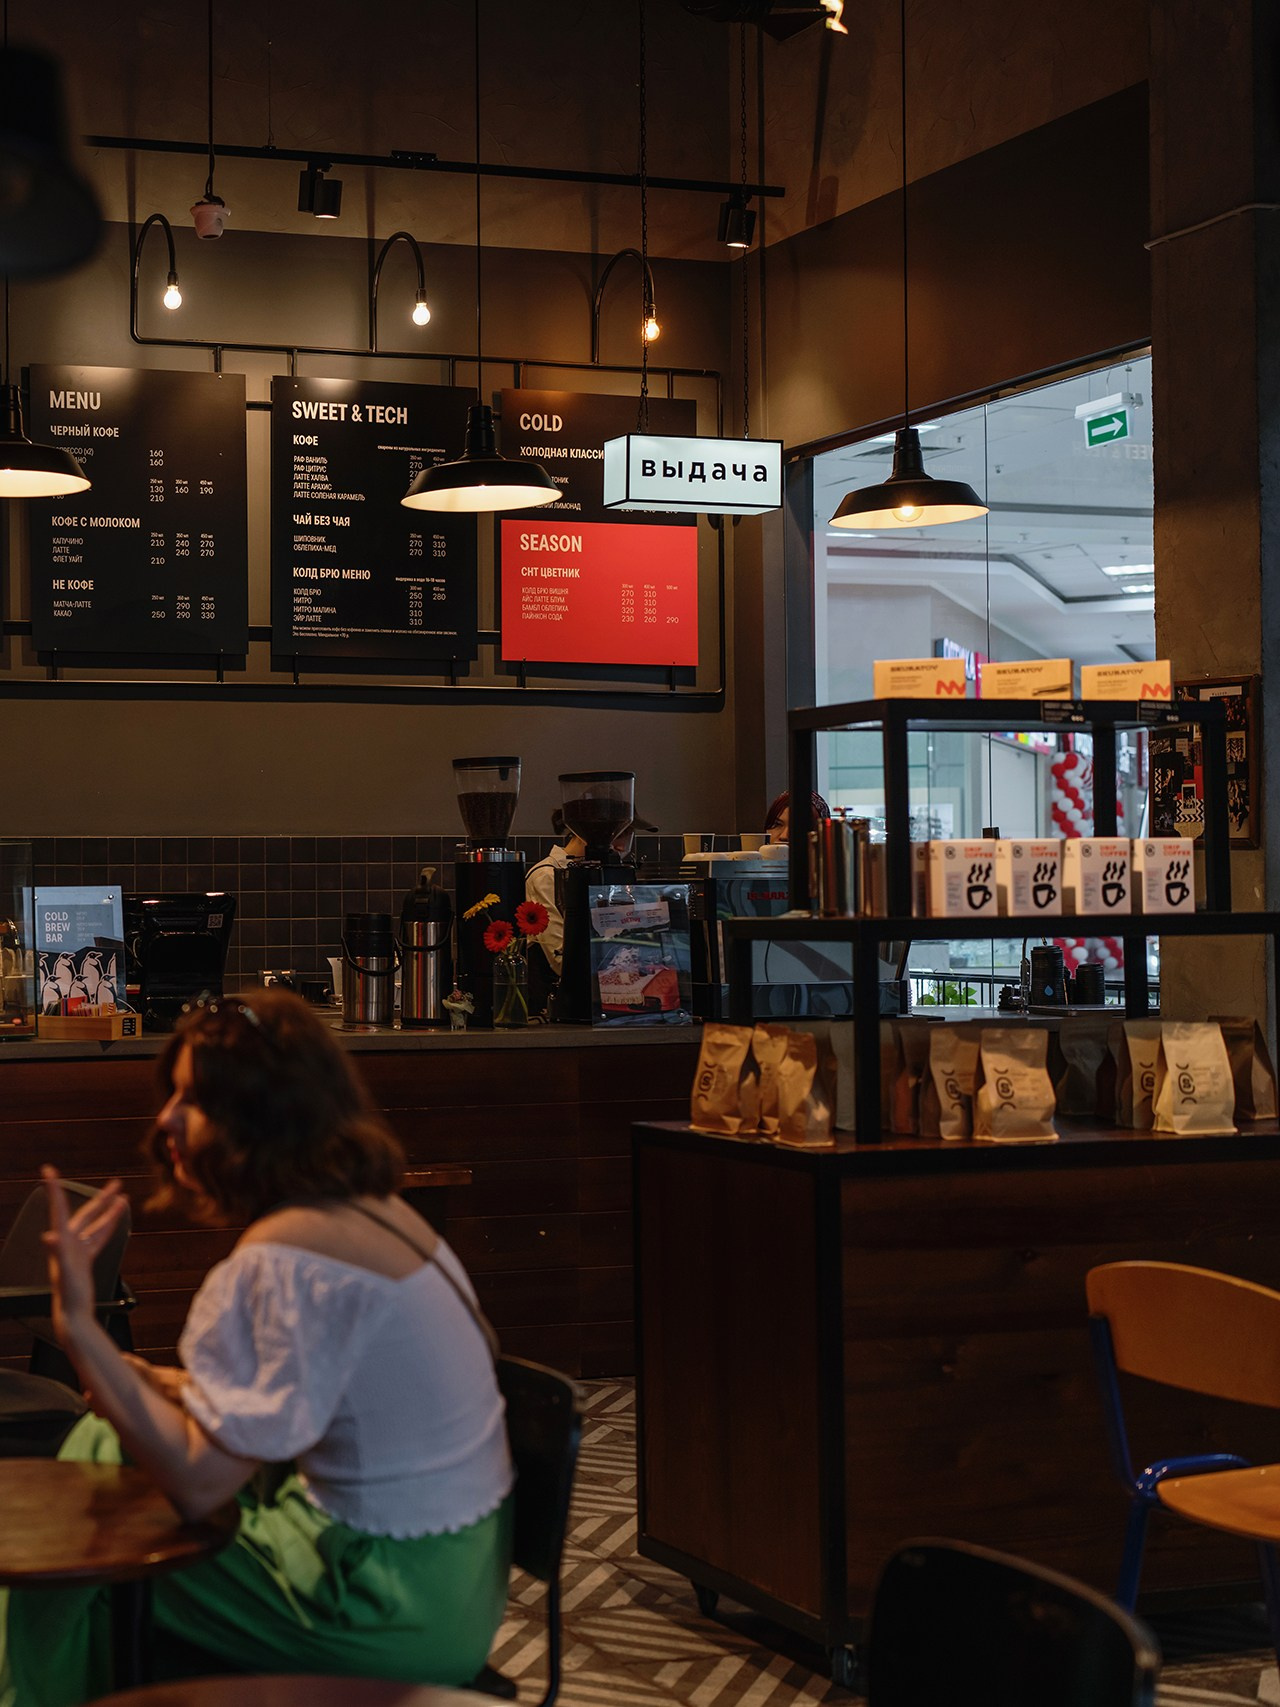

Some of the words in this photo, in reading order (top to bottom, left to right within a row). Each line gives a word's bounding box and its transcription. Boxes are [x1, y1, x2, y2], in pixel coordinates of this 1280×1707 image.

[50, 391, 101, 410] MENU
[292, 401, 348, 421] SWEET
[352, 405, 363, 422] &
[366, 405, 408, 425] TECH
[520, 413, 563, 432] COLD
[50, 424, 90, 437] ЧЕРНЫЙ
[93, 427, 119, 438] КОФЕ
[293, 435, 318, 446] КОФЕ
[520, 446, 568, 459] ХОЛОДНАЯ
[570, 448, 604, 460] КЛАССИ
[294, 456, 305, 464] РАФ
[306, 465, 327, 473] ЦИТРУС
[641, 459, 768, 482] выдача
[311, 474, 328, 482] ХАЛВА
[409, 470, 419, 478] 27
[175, 486, 189, 494] 160
[293, 482, 310, 490] ЛАТТЕ
[311, 483, 332, 491] АРАХИС
[293, 491, 310, 499] ЛАТТЕ
[337, 493, 366, 502] КАРАМЕЛЬ
[51, 516, 78, 527] КОФЕ
[80, 517, 87, 527] С
[90, 517, 140, 528] МОЛОКОМ
[293, 513, 312, 526] ЧАЙ
[314, 515, 331, 526] БЕЗ
[333, 516, 351, 527] ЧАЯ
[52, 537, 84, 545] КАПУЧИНО
[150, 539, 165, 547] 210
[200, 540, 214, 548] 270
[294, 535, 326, 543] ШИПОВНИК
[520, 534, 582, 552] SEASON
[409, 540, 423, 548] 270
[52, 546, 70, 554] ЛАТТЕ
[200, 549, 215, 557] 270
[409, 549, 423, 557] 270
[151, 557, 166, 565] 210
[293, 567, 318, 579] КОЛД
[320, 568, 340, 579] БРЮ
[342, 569, 371, 580] МЕНЮ
[521, 567, 539, 577] СНТ
[541, 567, 580, 579] ЦВЕТНИК
[53, 580, 65, 589] НЕ
[68, 580, 94, 590] КОФЕ
[293, 588, 308, 596] КОЛД
[409, 592, 423, 600] 250
[176, 602, 191, 610] 290
[201, 602, 215, 610] 330
[313, 606, 337, 614] МАЛИНА
[176, 611, 191, 619] 290
[45, 912, 68, 921] COLD
[45, 923, 71, 932] BREW
[46, 934, 63, 943] BAR
